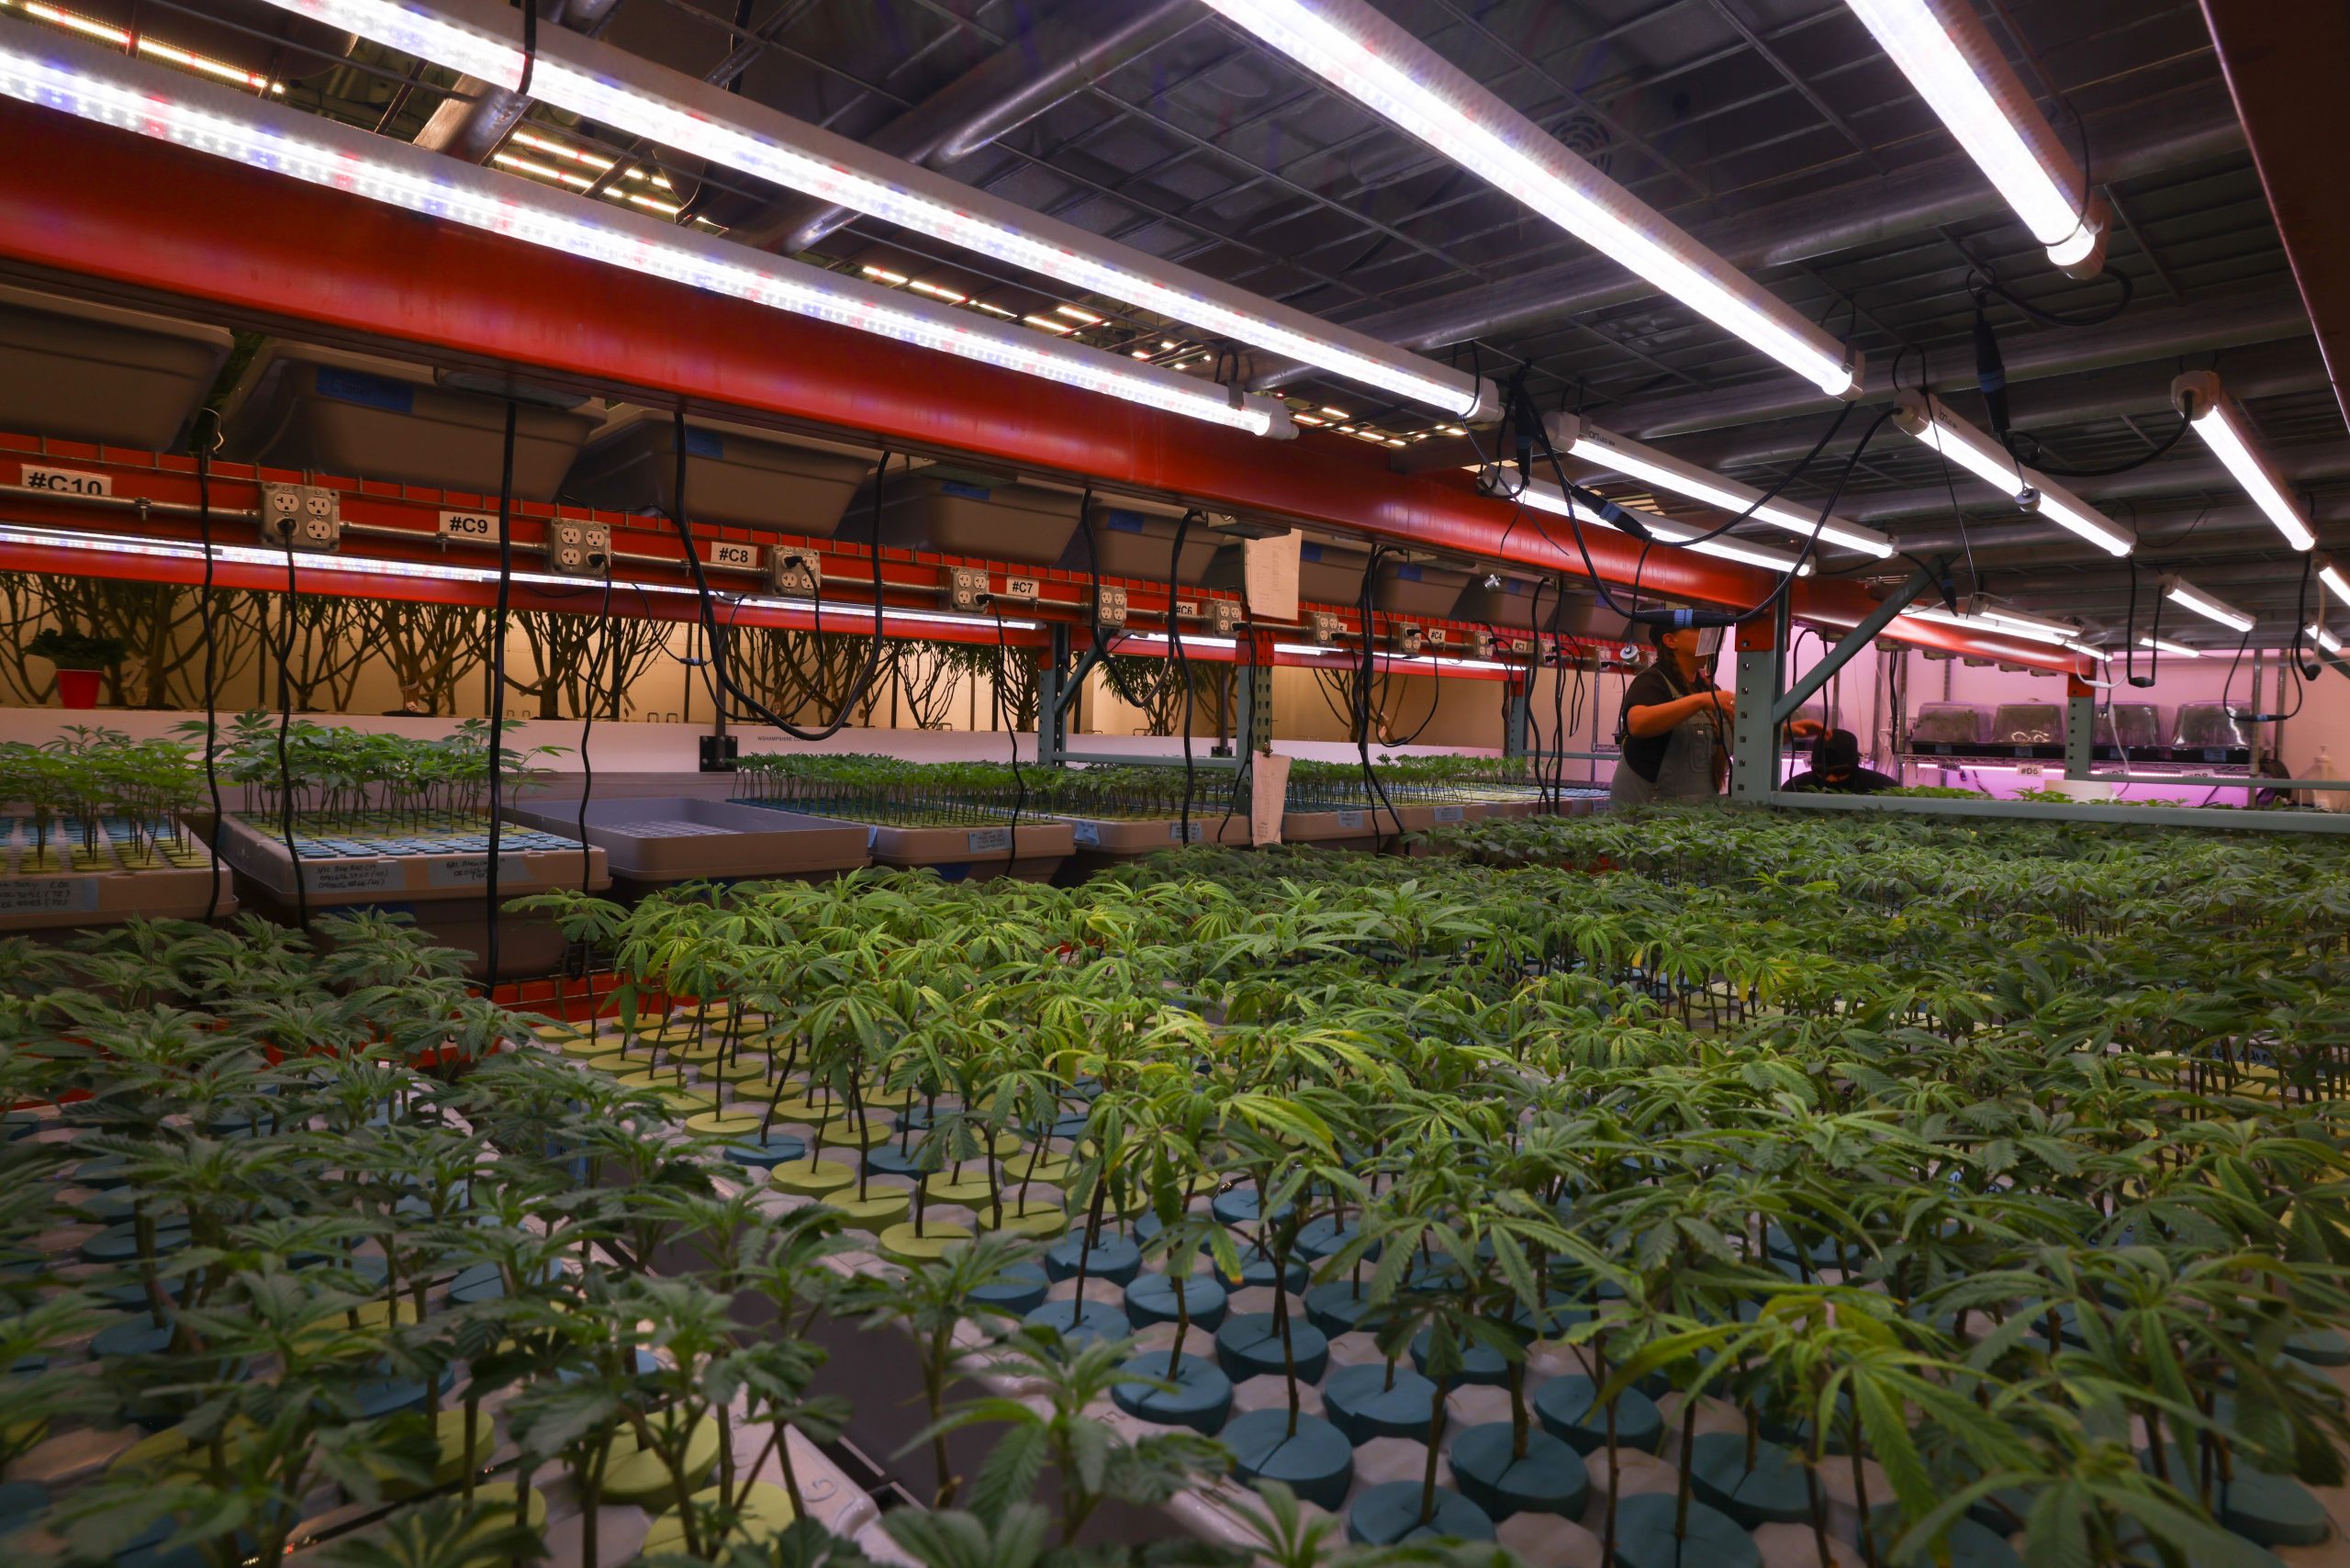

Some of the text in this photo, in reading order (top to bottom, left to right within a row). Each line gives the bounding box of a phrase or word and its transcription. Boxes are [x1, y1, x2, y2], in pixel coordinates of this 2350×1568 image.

[449, 516, 488, 534] #C9
[719, 546, 749, 563] #C8
[1012, 581, 1034, 593] #C7
[1430, 631, 1442, 640] #C4
